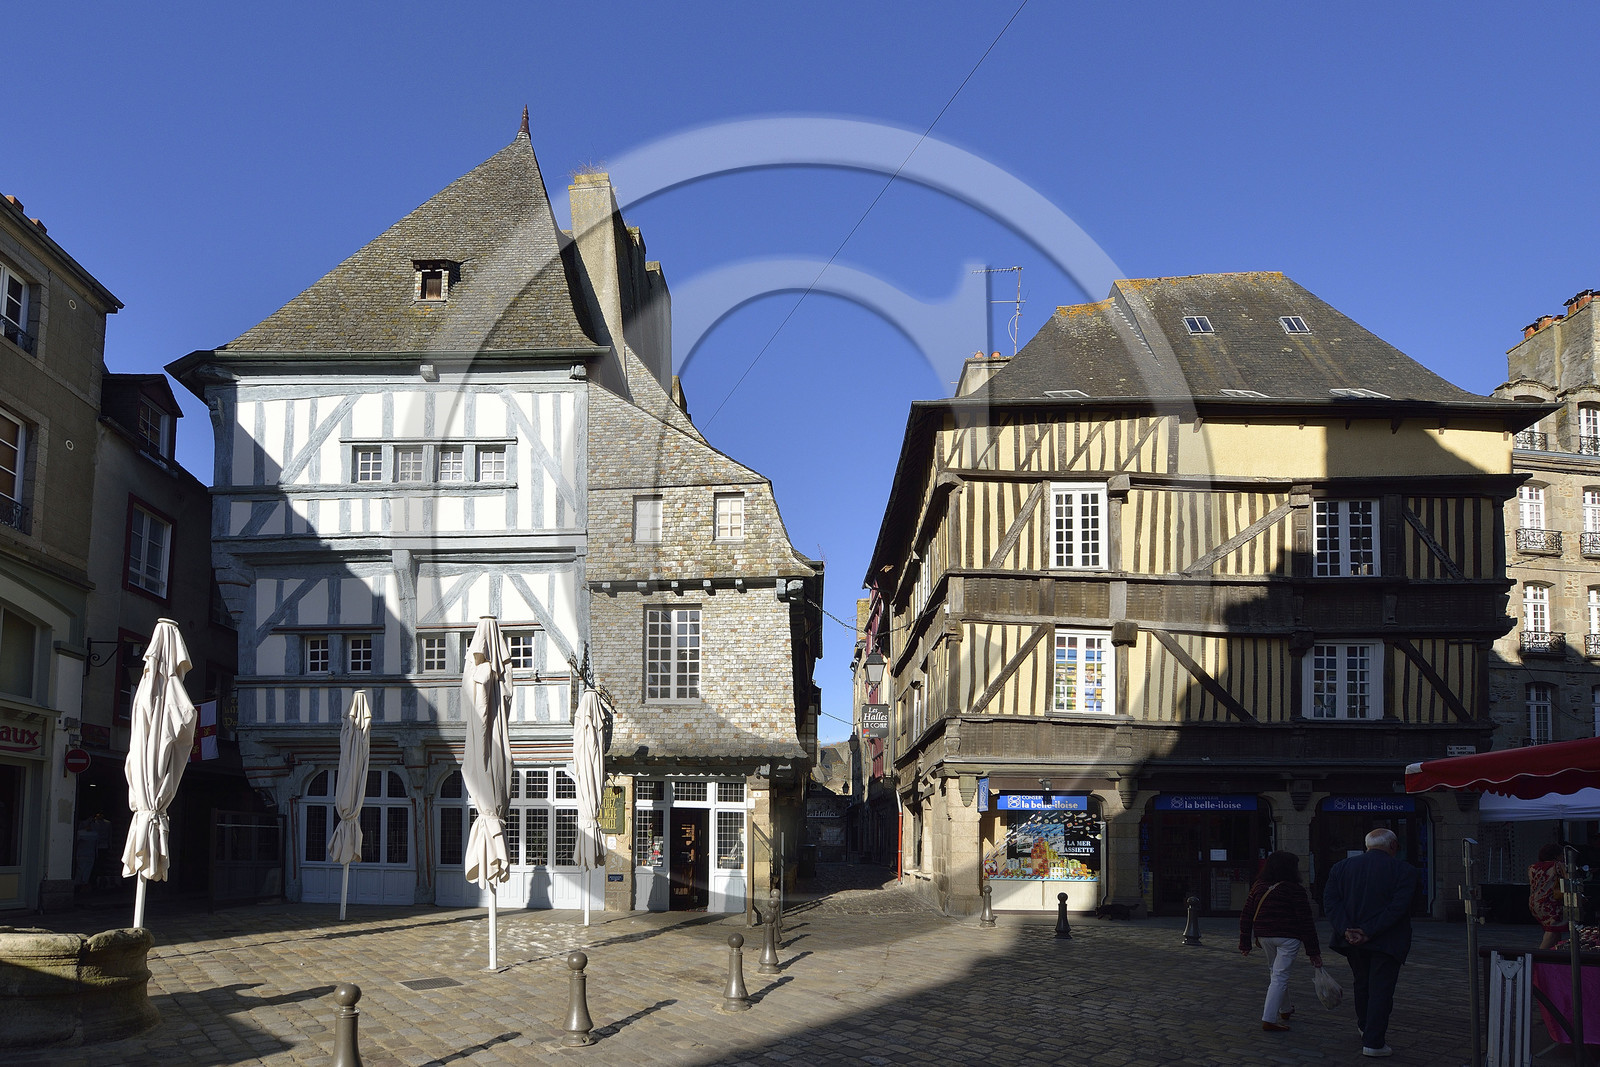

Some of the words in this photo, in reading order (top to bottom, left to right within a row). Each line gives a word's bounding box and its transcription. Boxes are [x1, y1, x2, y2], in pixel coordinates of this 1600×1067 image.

[864, 712, 888, 720] Halles
[1021, 800, 1029, 809] la
[1184, 800, 1192, 809] la
[1194, 800, 1242, 809] belle-iloise
[1347, 802, 1355, 810] la
[1357, 802, 1404, 810] belle-iloise
